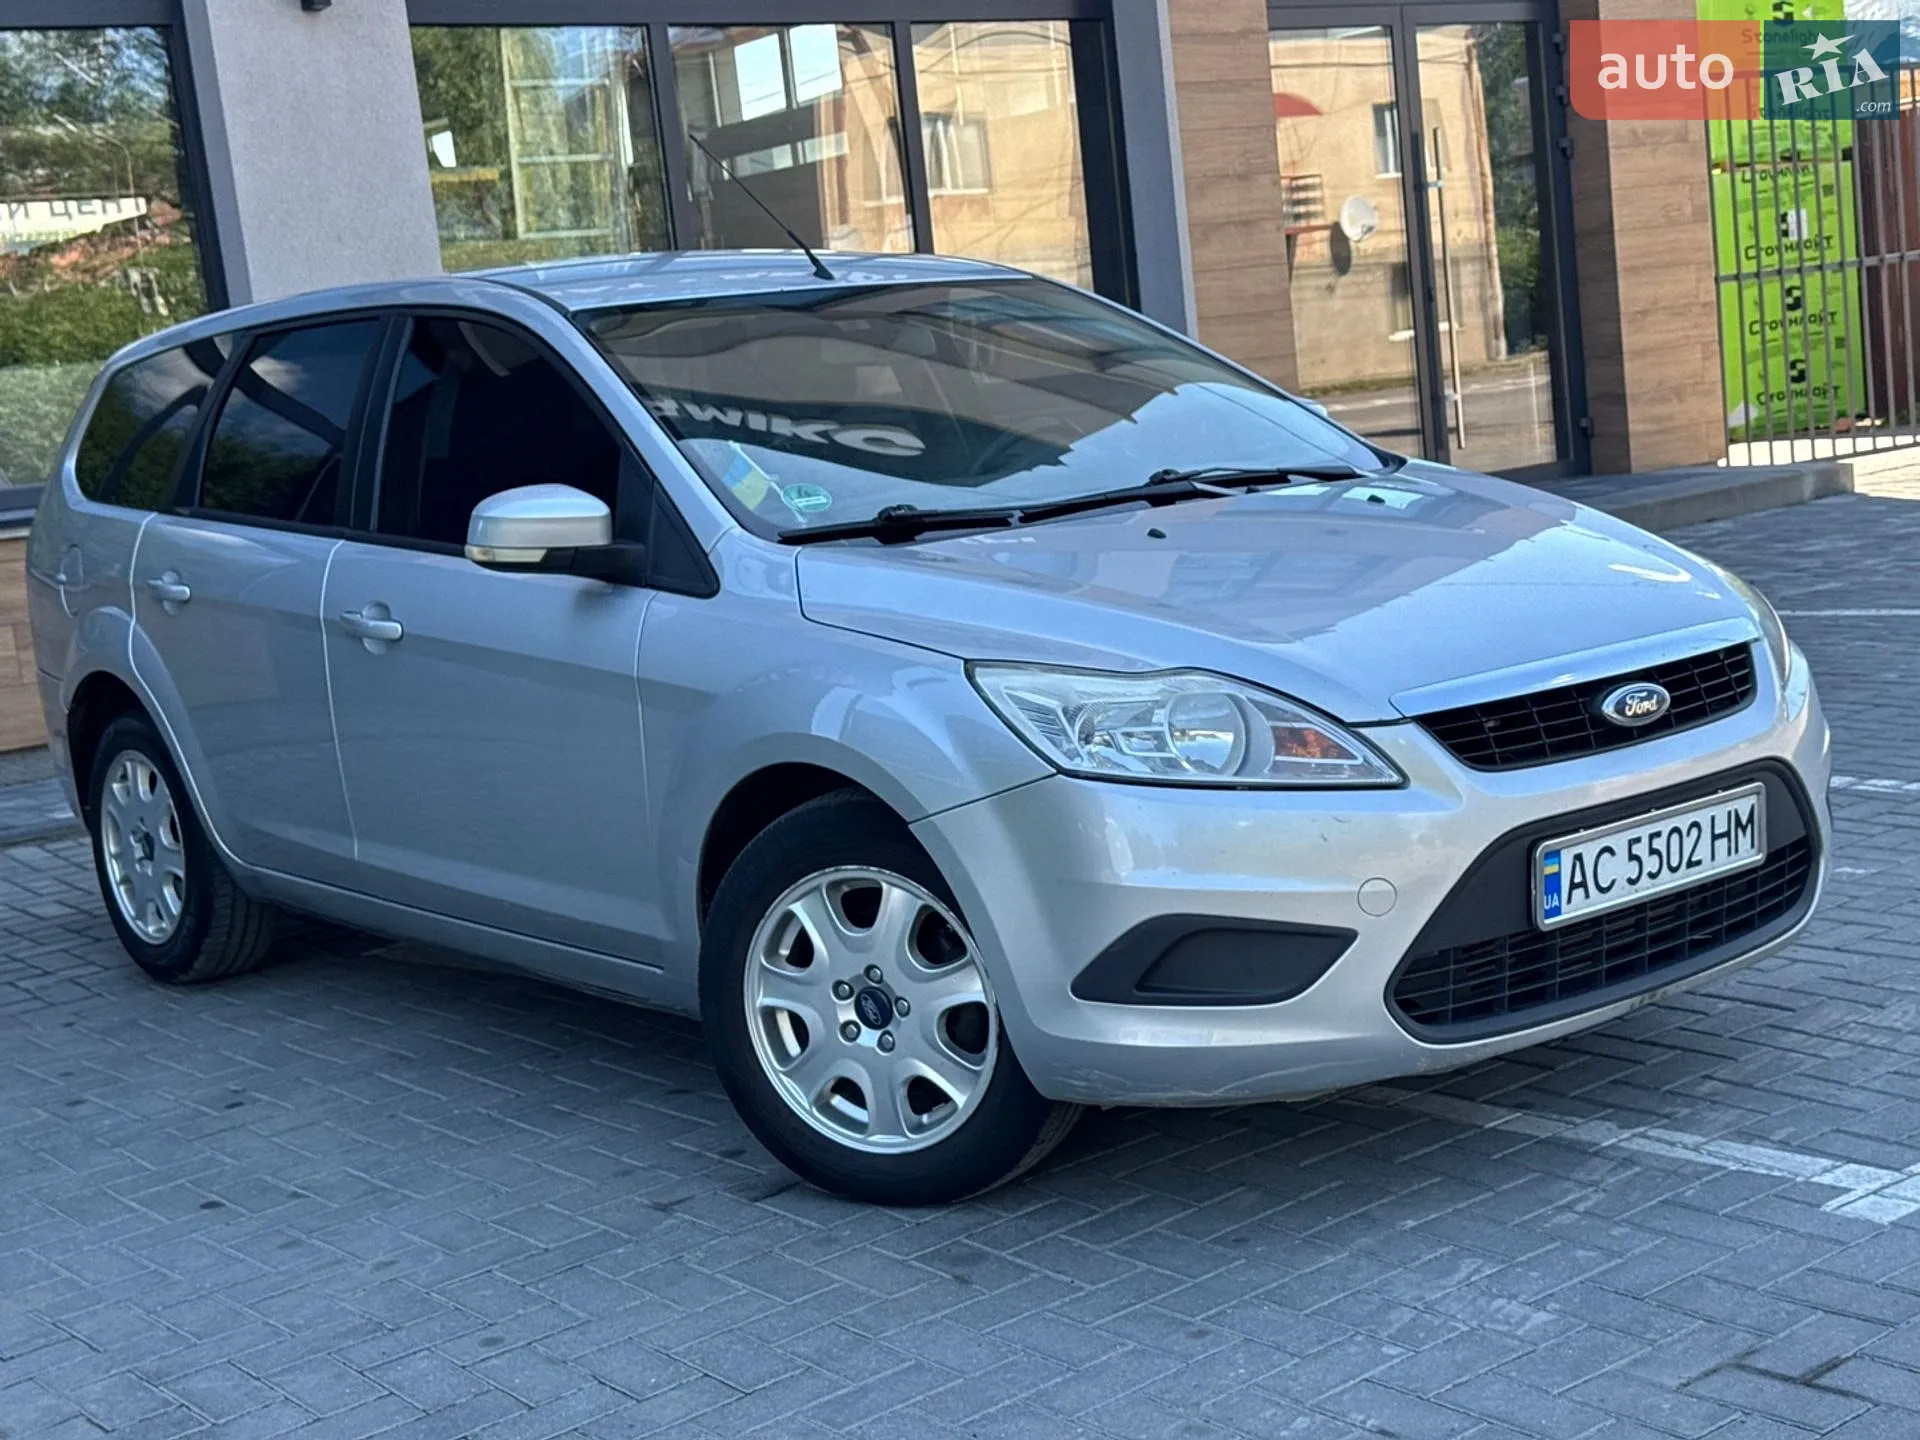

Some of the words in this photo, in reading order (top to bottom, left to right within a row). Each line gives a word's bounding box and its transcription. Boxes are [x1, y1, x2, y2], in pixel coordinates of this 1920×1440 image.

[1741, 28, 1823, 45] Stoneligh
[1625, 691, 1658, 716] Ford
[1566, 846, 1617, 905] AC
[1625, 820, 1703, 887] 5502
[1710, 803, 1756, 863] HM
[1543, 892, 1560, 910] UA
